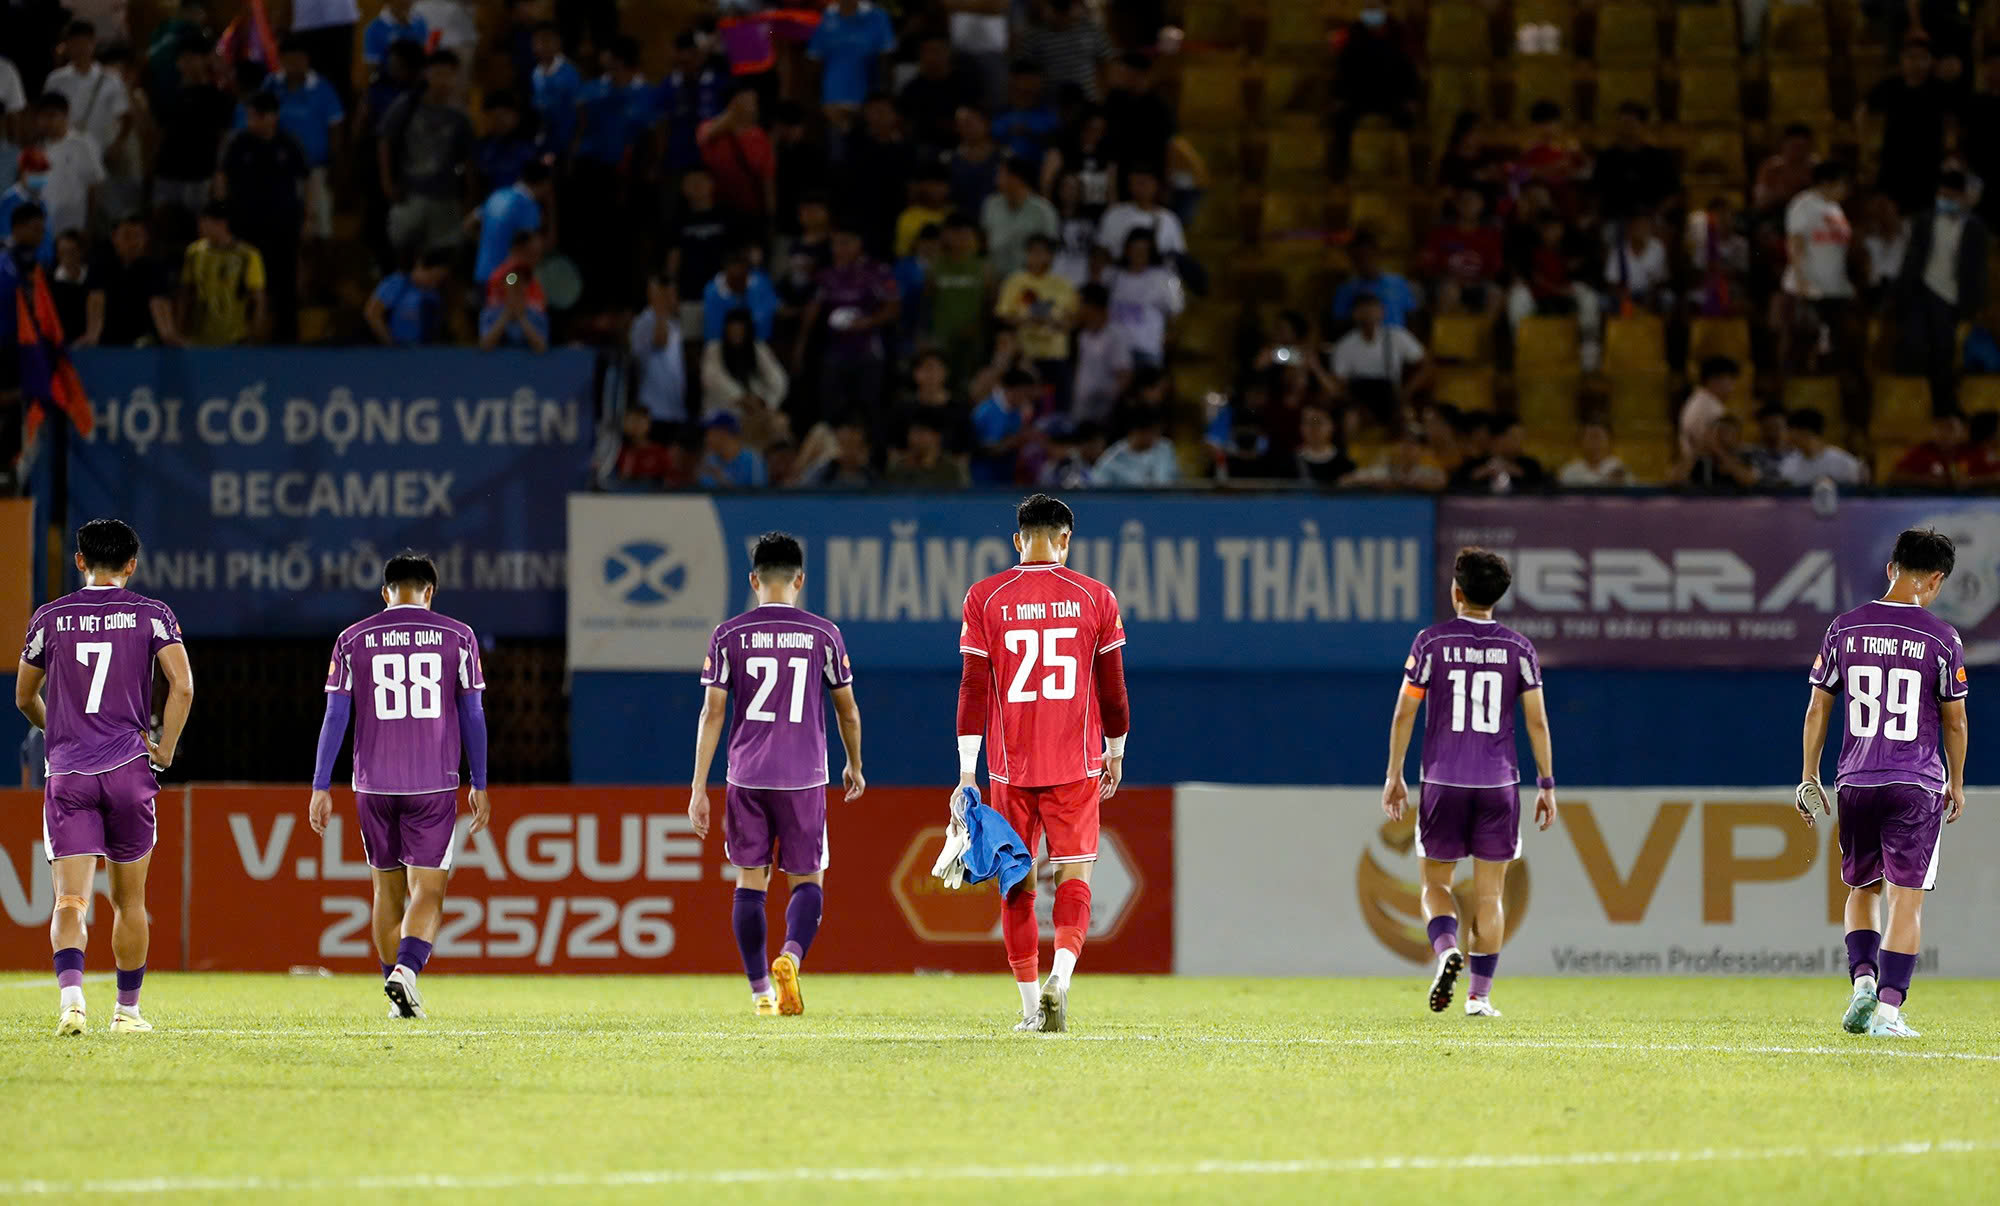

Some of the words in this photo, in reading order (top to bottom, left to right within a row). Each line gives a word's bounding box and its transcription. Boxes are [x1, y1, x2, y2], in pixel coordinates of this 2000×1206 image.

[86, 386, 183, 456] HỘI
[283, 386, 442, 456] ĐỘNG
[453, 386, 578, 446] VIÊN
[209, 471, 455, 518] BECAMEX
[1215, 519, 1421, 623] THÀNH
[1495, 547, 1837, 615] ERRA
[79, 614, 101, 634] VIỆT
[365, 633, 378, 648] M.
[415, 629, 442, 647] QUÂN
[740, 633, 749, 649] T.
[751, 631, 773, 649] ĐÌNH
[1001, 605, 1012, 621] T.
[1016, 603, 1046, 620] MINH
[1051, 600, 1080, 618] TOÀN
[76, 642, 112, 713] 7
[1004, 627, 1078, 703] 25
[1846, 636, 1856, 653] N.
[1862, 636, 1898, 656] TRỌNG
[1902, 640, 1925, 659] PHÚ
[372, 653, 442, 720] 88
[746, 657, 808, 723] 21
[1448, 670, 1503, 734] 10
[1848, 665, 1922, 741] 89
[228, 813, 703, 880] V.LAGUE
[319, 896, 674, 965] 225/26
[1551, 944, 1662, 973] Vietnam
[1667, 943, 1825, 973] Professional
